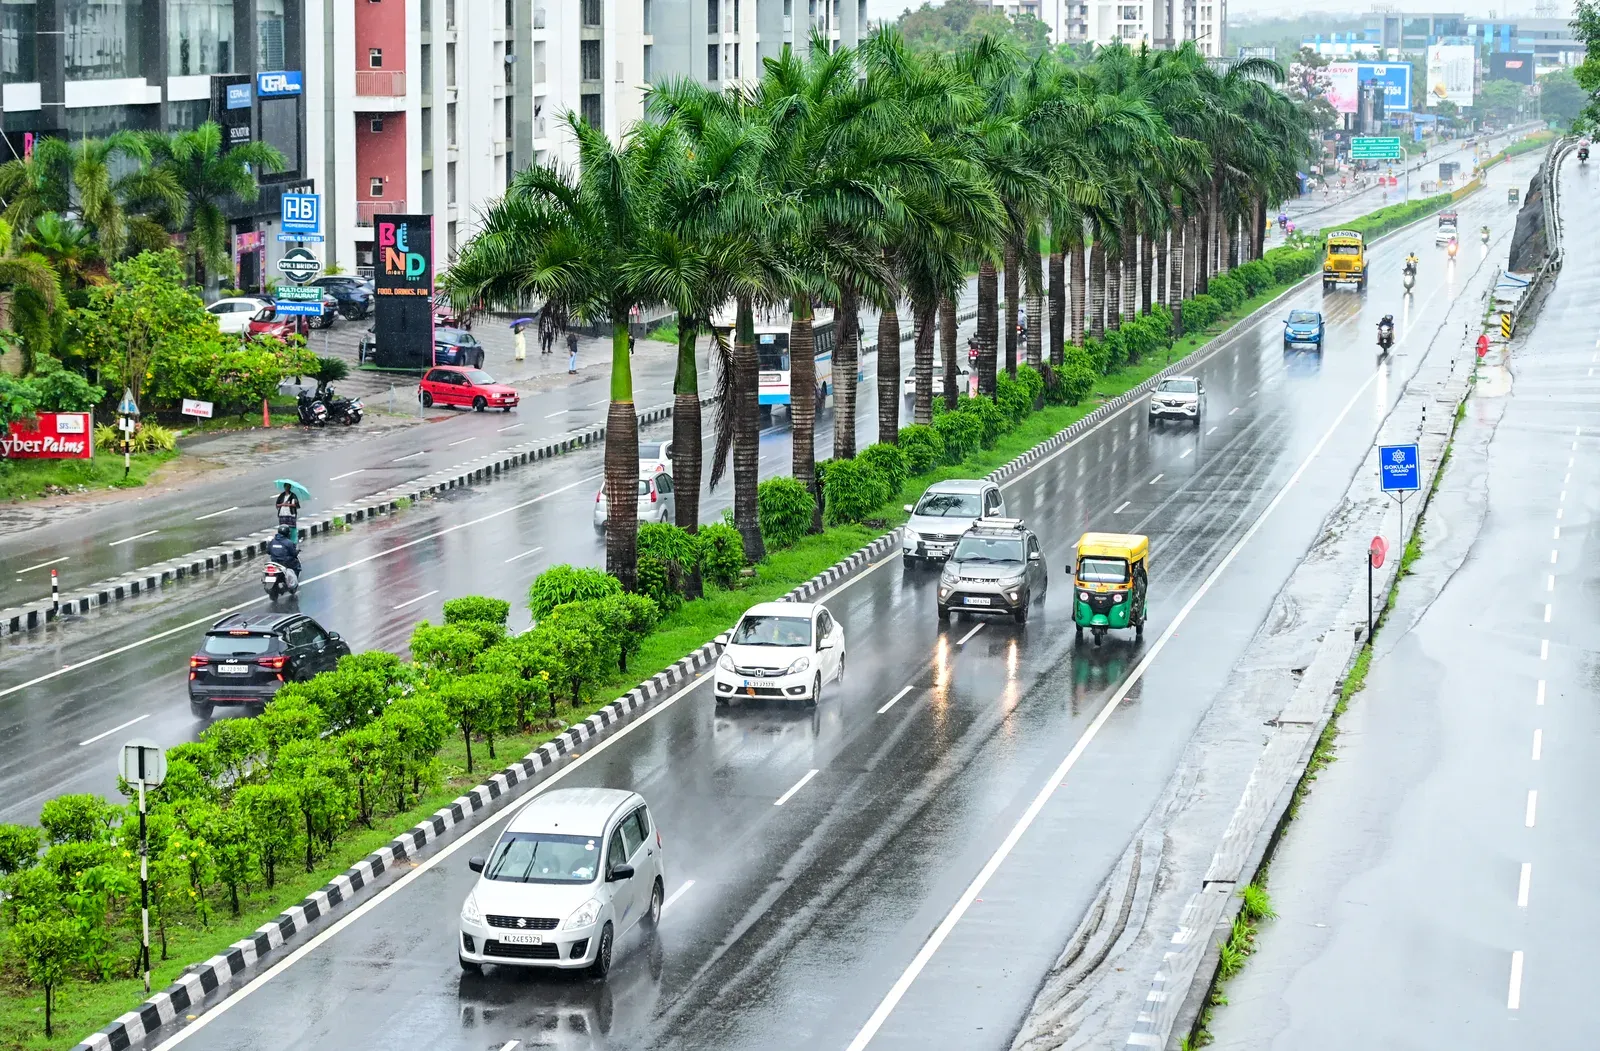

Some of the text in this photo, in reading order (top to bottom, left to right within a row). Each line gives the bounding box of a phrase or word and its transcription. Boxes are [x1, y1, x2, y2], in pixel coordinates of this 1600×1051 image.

[262, 74, 287, 92] CERA
[230, 126, 250, 138] SENATOR
[287, 197, 313, 219] HB
[0, 433, 85, 457] yber Palms
